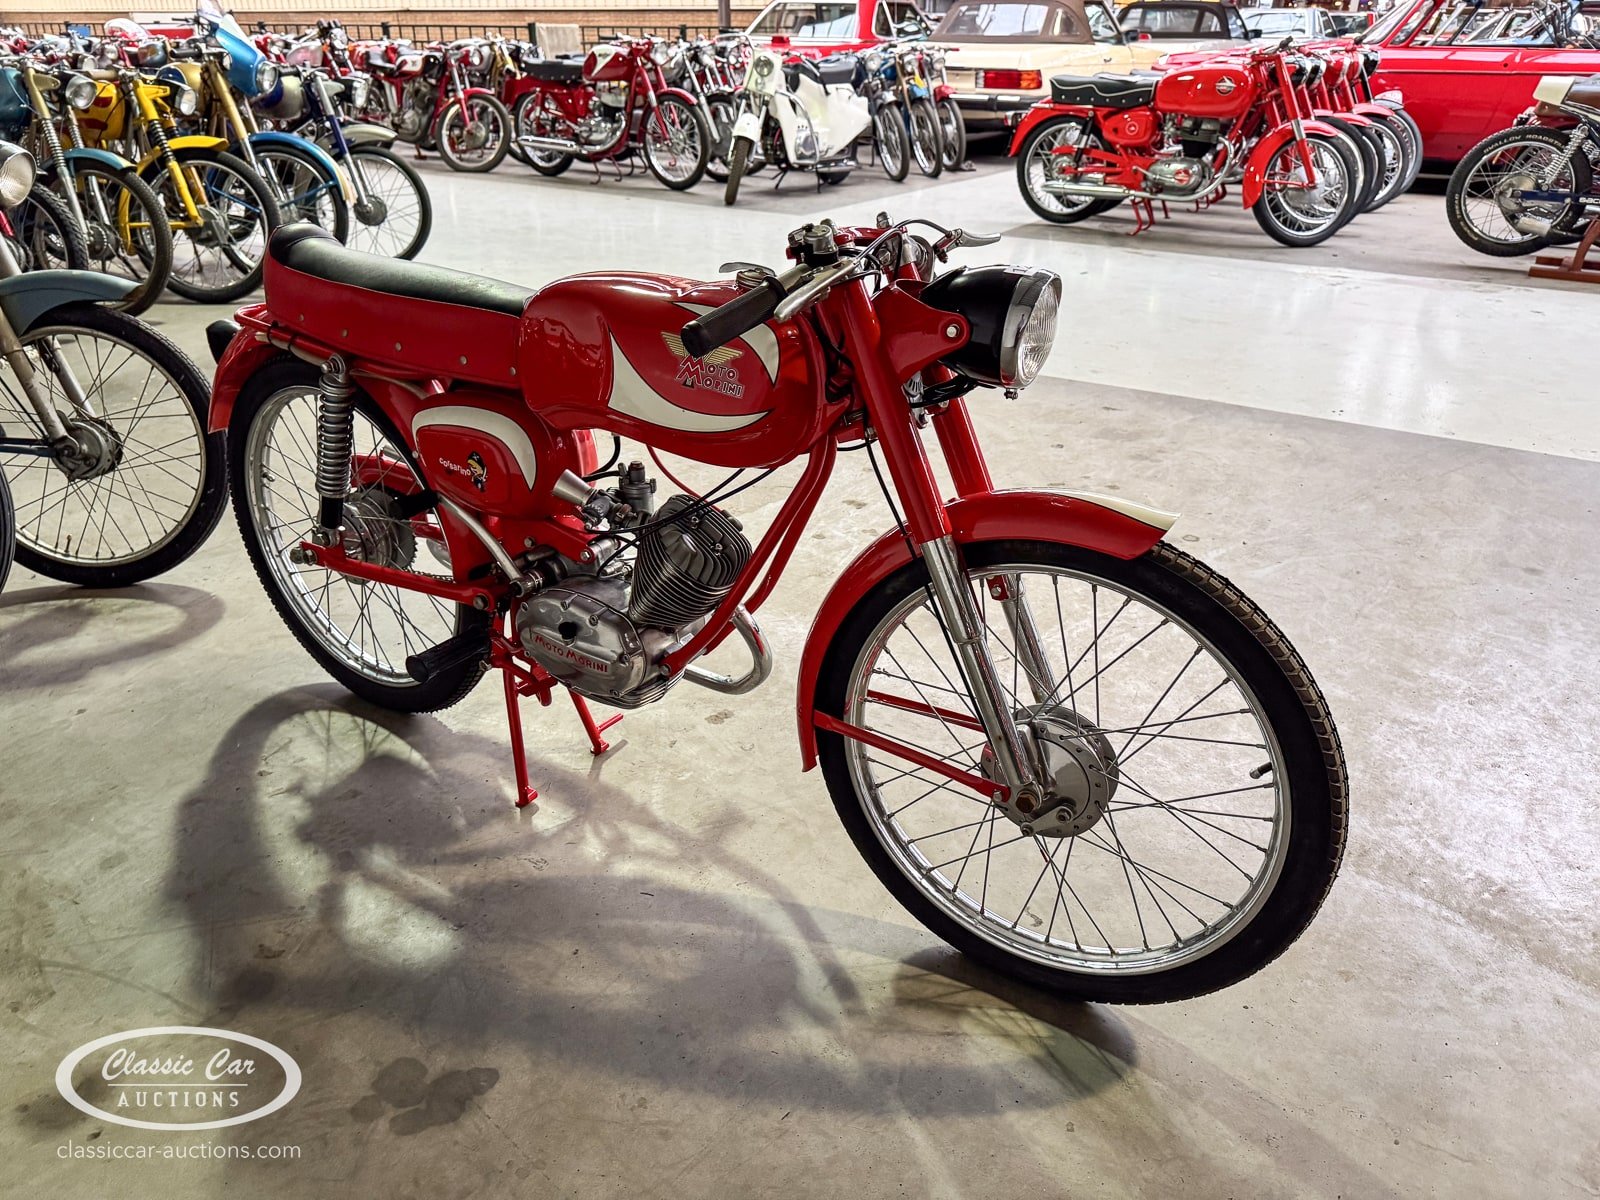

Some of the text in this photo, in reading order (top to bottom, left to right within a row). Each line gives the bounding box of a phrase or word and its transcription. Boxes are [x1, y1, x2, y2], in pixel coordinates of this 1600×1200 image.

[675, 362, 743, 397] MORINI
[679, 354, 737, 380] MOTO
[535, 635, 608, 673] MOTO MORINI
